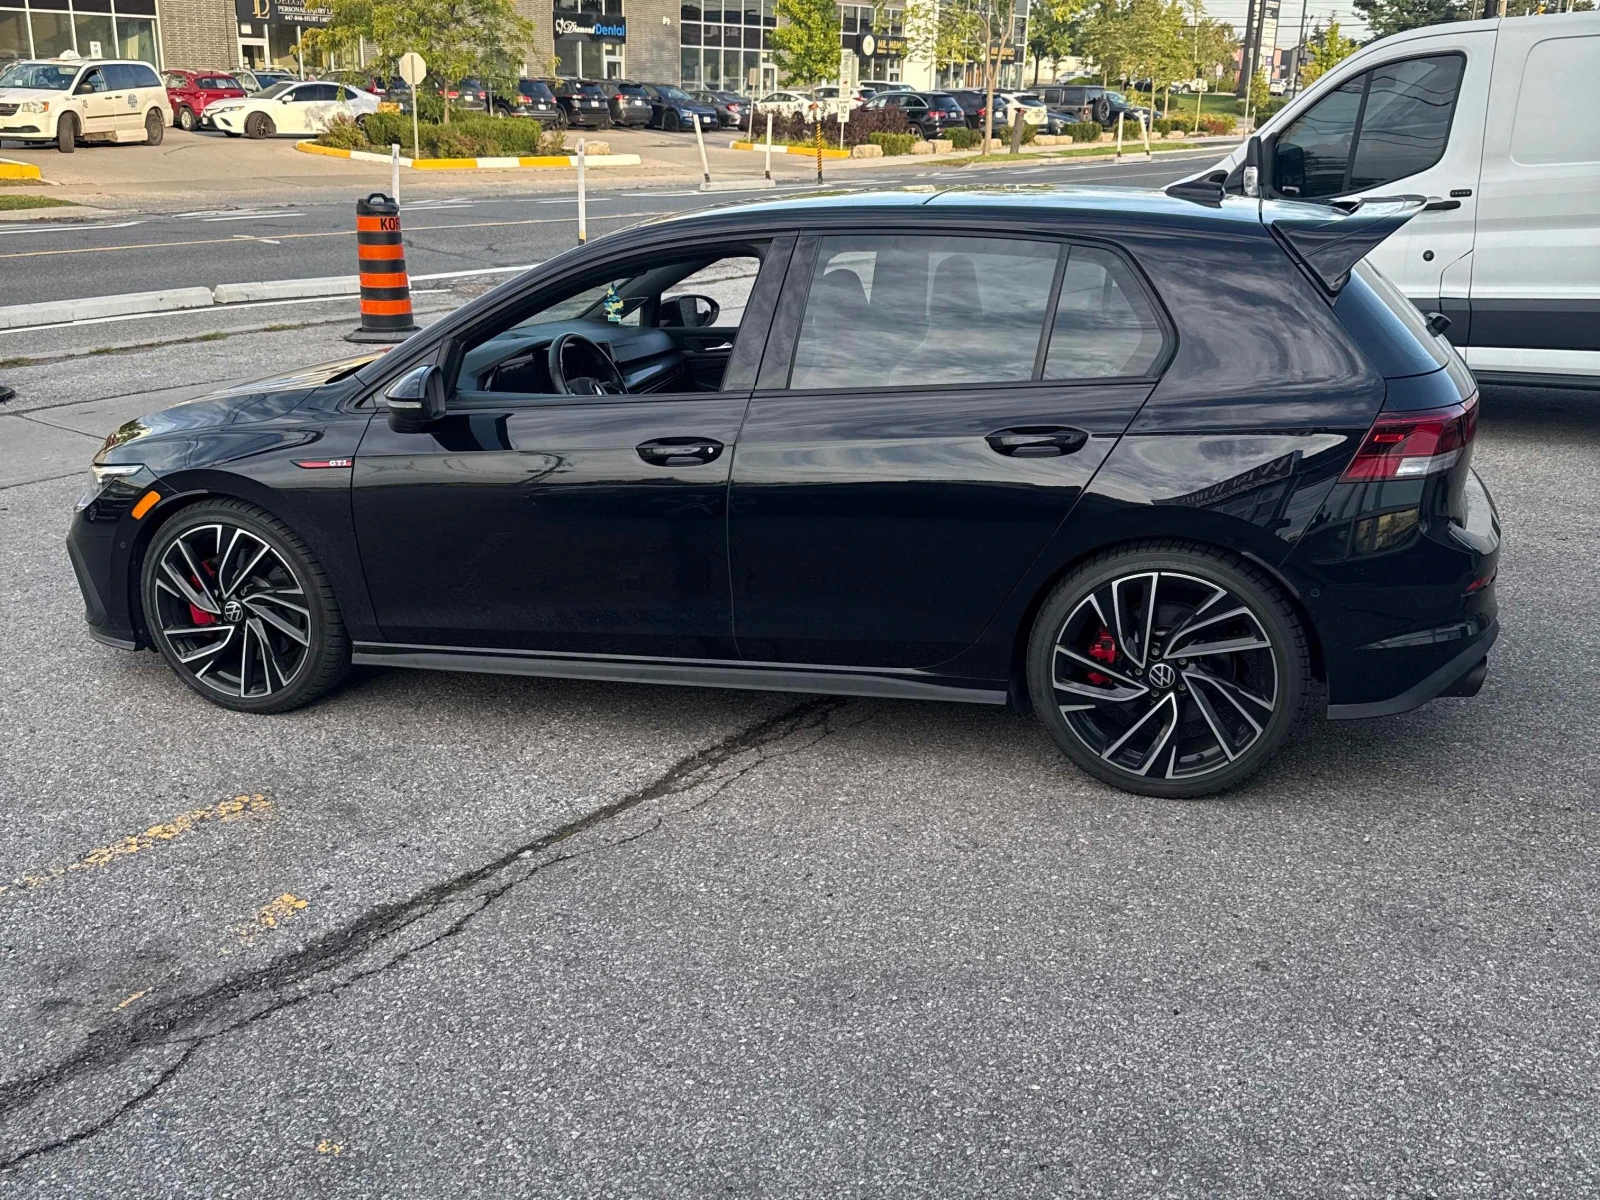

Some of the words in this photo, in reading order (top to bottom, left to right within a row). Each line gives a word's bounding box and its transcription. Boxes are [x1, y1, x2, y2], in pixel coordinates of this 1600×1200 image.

[563, 20, 595, 34] Diamond
[595, 24, 625, 36] Dental
[840, 105, 847, 114] 10
